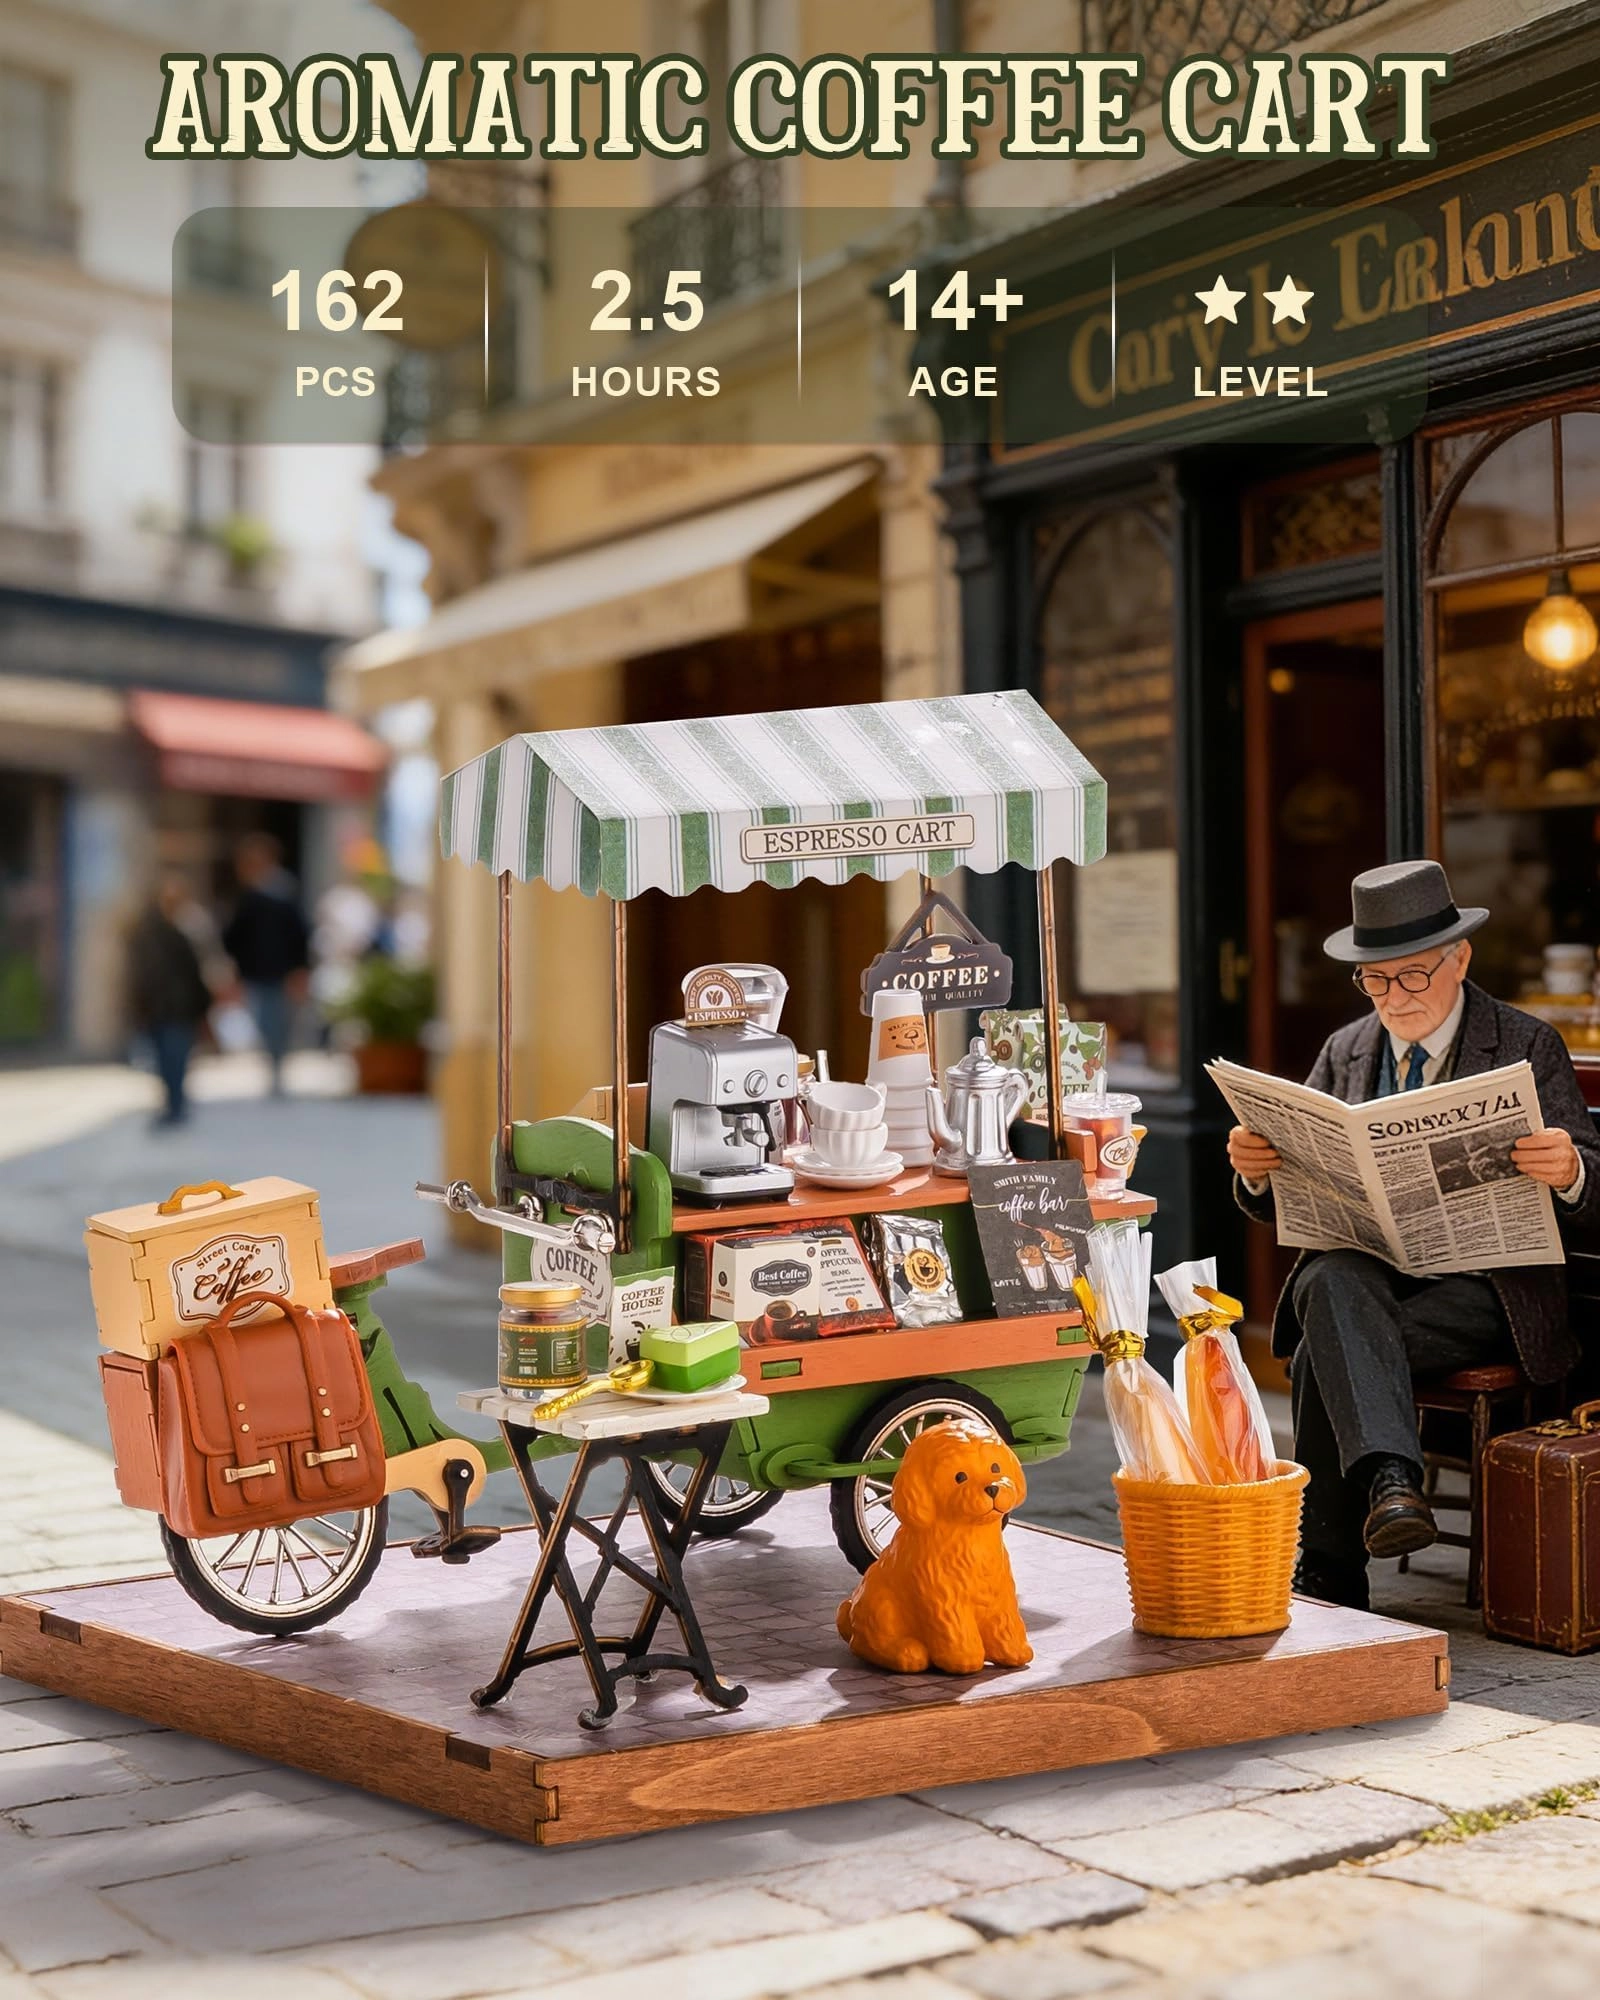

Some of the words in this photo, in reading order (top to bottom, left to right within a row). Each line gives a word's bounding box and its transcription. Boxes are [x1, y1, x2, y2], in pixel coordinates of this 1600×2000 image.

[764, 825, 887, 855] ESPRESSO
[896, 820, 956, 845] CART
[892, 965, 989, 990] COFFEE
[945, 989, 984, 1001] QUALITY
[694, 1010, 740, 1021] ESPRESSO
[993, 1175, 1020, 1189] SMITH
[1022, 1174, 1057, 1185] FAMILY
[999, 1194, 1036, 1222] coffee
[1039, 1187, 1068, 1215] bar
[196, 1244, 228, 1269] Street
[820, 1247, 849, 1258] OFFEE
[546, 1246, 598, 1286] COFFEE
[820, 1257, 862, 1269] PPUCCINO
[193, 1254, 274, 1305] Coffee
[758, 1271, 778, 1282] Best
[780, 1269, 808, 1280] Coffee
[621, 1286, 665, 1302] COFFEE
[621, 1296, 663, 1312] HOUSE
